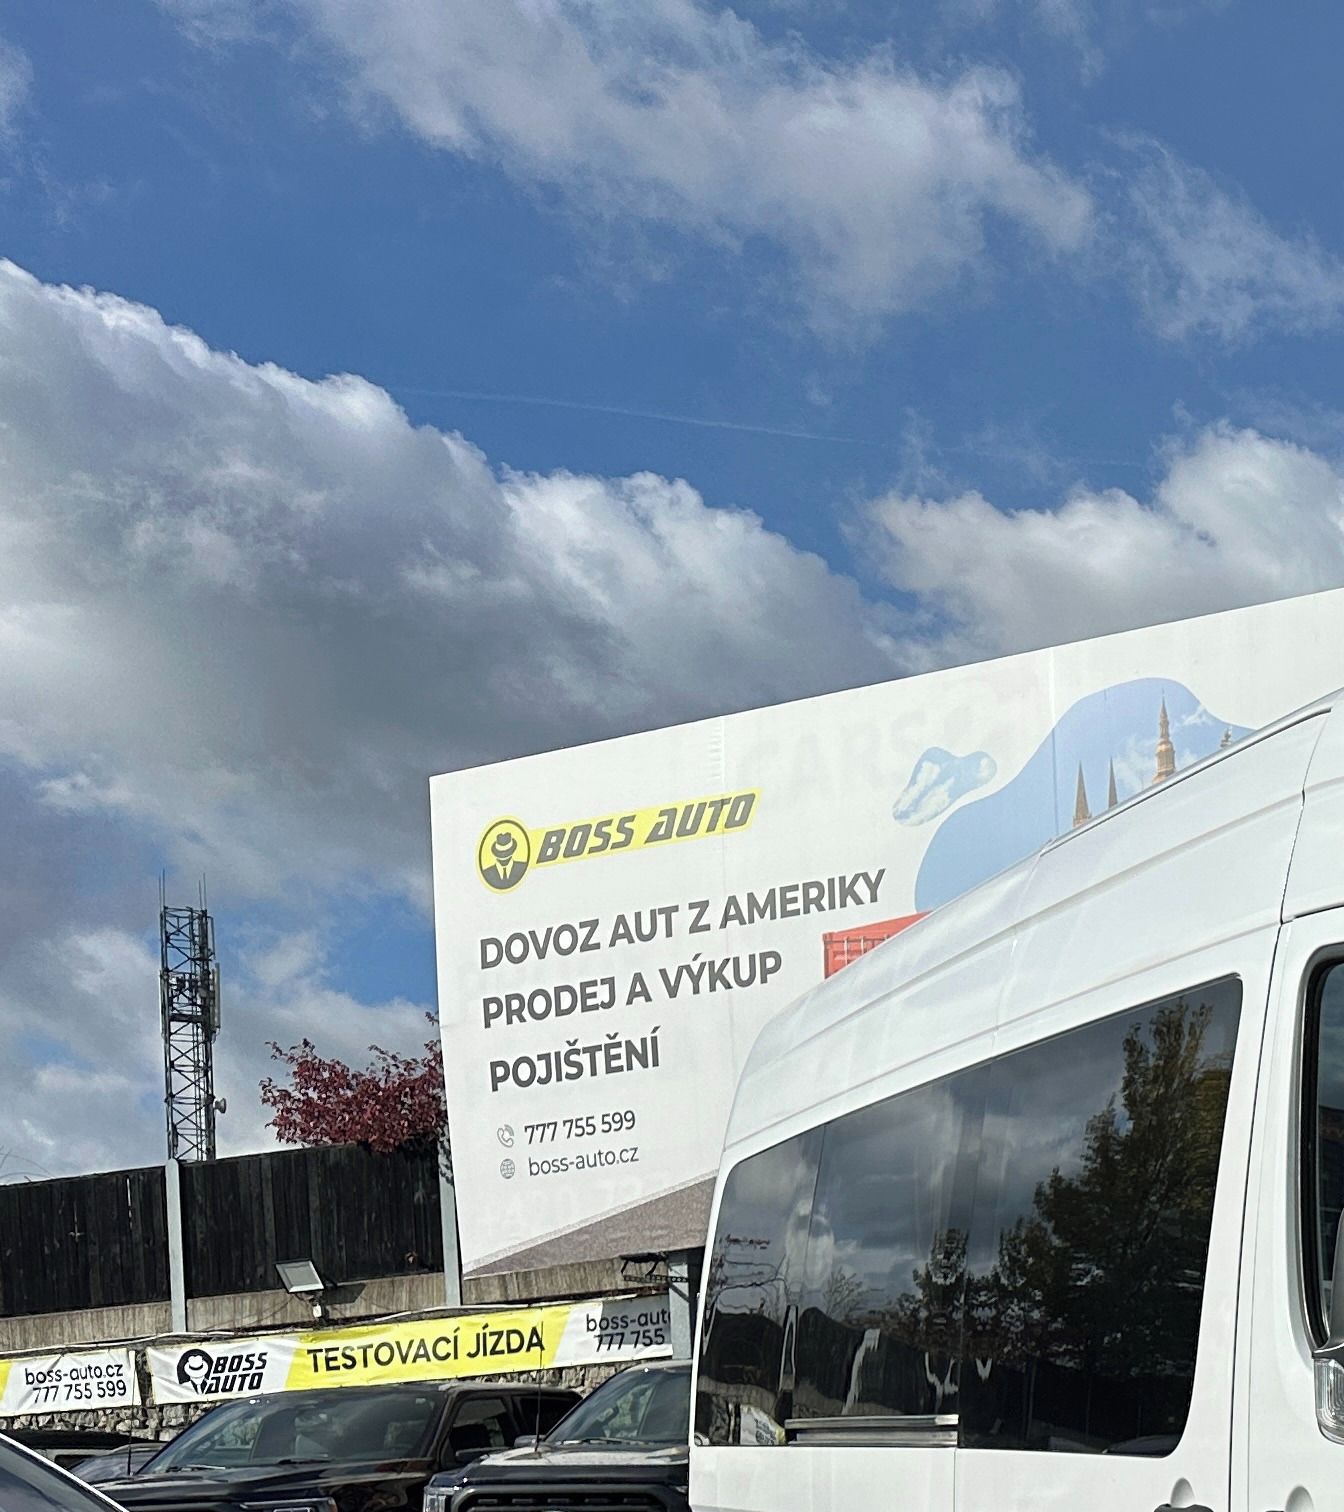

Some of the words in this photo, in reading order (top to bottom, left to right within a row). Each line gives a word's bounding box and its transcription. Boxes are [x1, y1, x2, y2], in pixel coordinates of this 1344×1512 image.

[536, 814, 636, 864] BOSS
[644, 792, 756, 844] AUTO
[480, 918, 600, 970] DOVOZ
[609, 905, 679, 947] AUT
[688, 900, 711, 934] Z
[719, 868, 886, 929] AMERIKY
[482, 975, 616, 1029] PRODEJ
[626, 972, 653, 1006] A
[659, 950, 783, 999] VÝKUP
[489, 1025, 661, 1092] POJIŠTĚNÍ
[524, 1121, 558, 1145] 777
[563, 1115, 596, 1139] 755
[601, 1110, 636, 1133] 599
[529, 1147, 639, 1176] boss-auto.cz
[586, 1308, 671, 1332] boss-aut
[307, 1327, 461, 1373] TESTOVACÍ
[467, 1323, 546, 1358] JÍZDA
[594, 1332, 625, 1352] 777
[630, 1328, 665, 1349] 755
[25, 1364, 124, 1385] boss-auto.cz
[212, 1352, 268, 1374] BOSS
[33, 1384, 60, 1404] 777
[64, 1382, 93, 1400] 755
[97, 1380, 127, 1398] 599
[205, 1372, 263, 1394] AUTO
